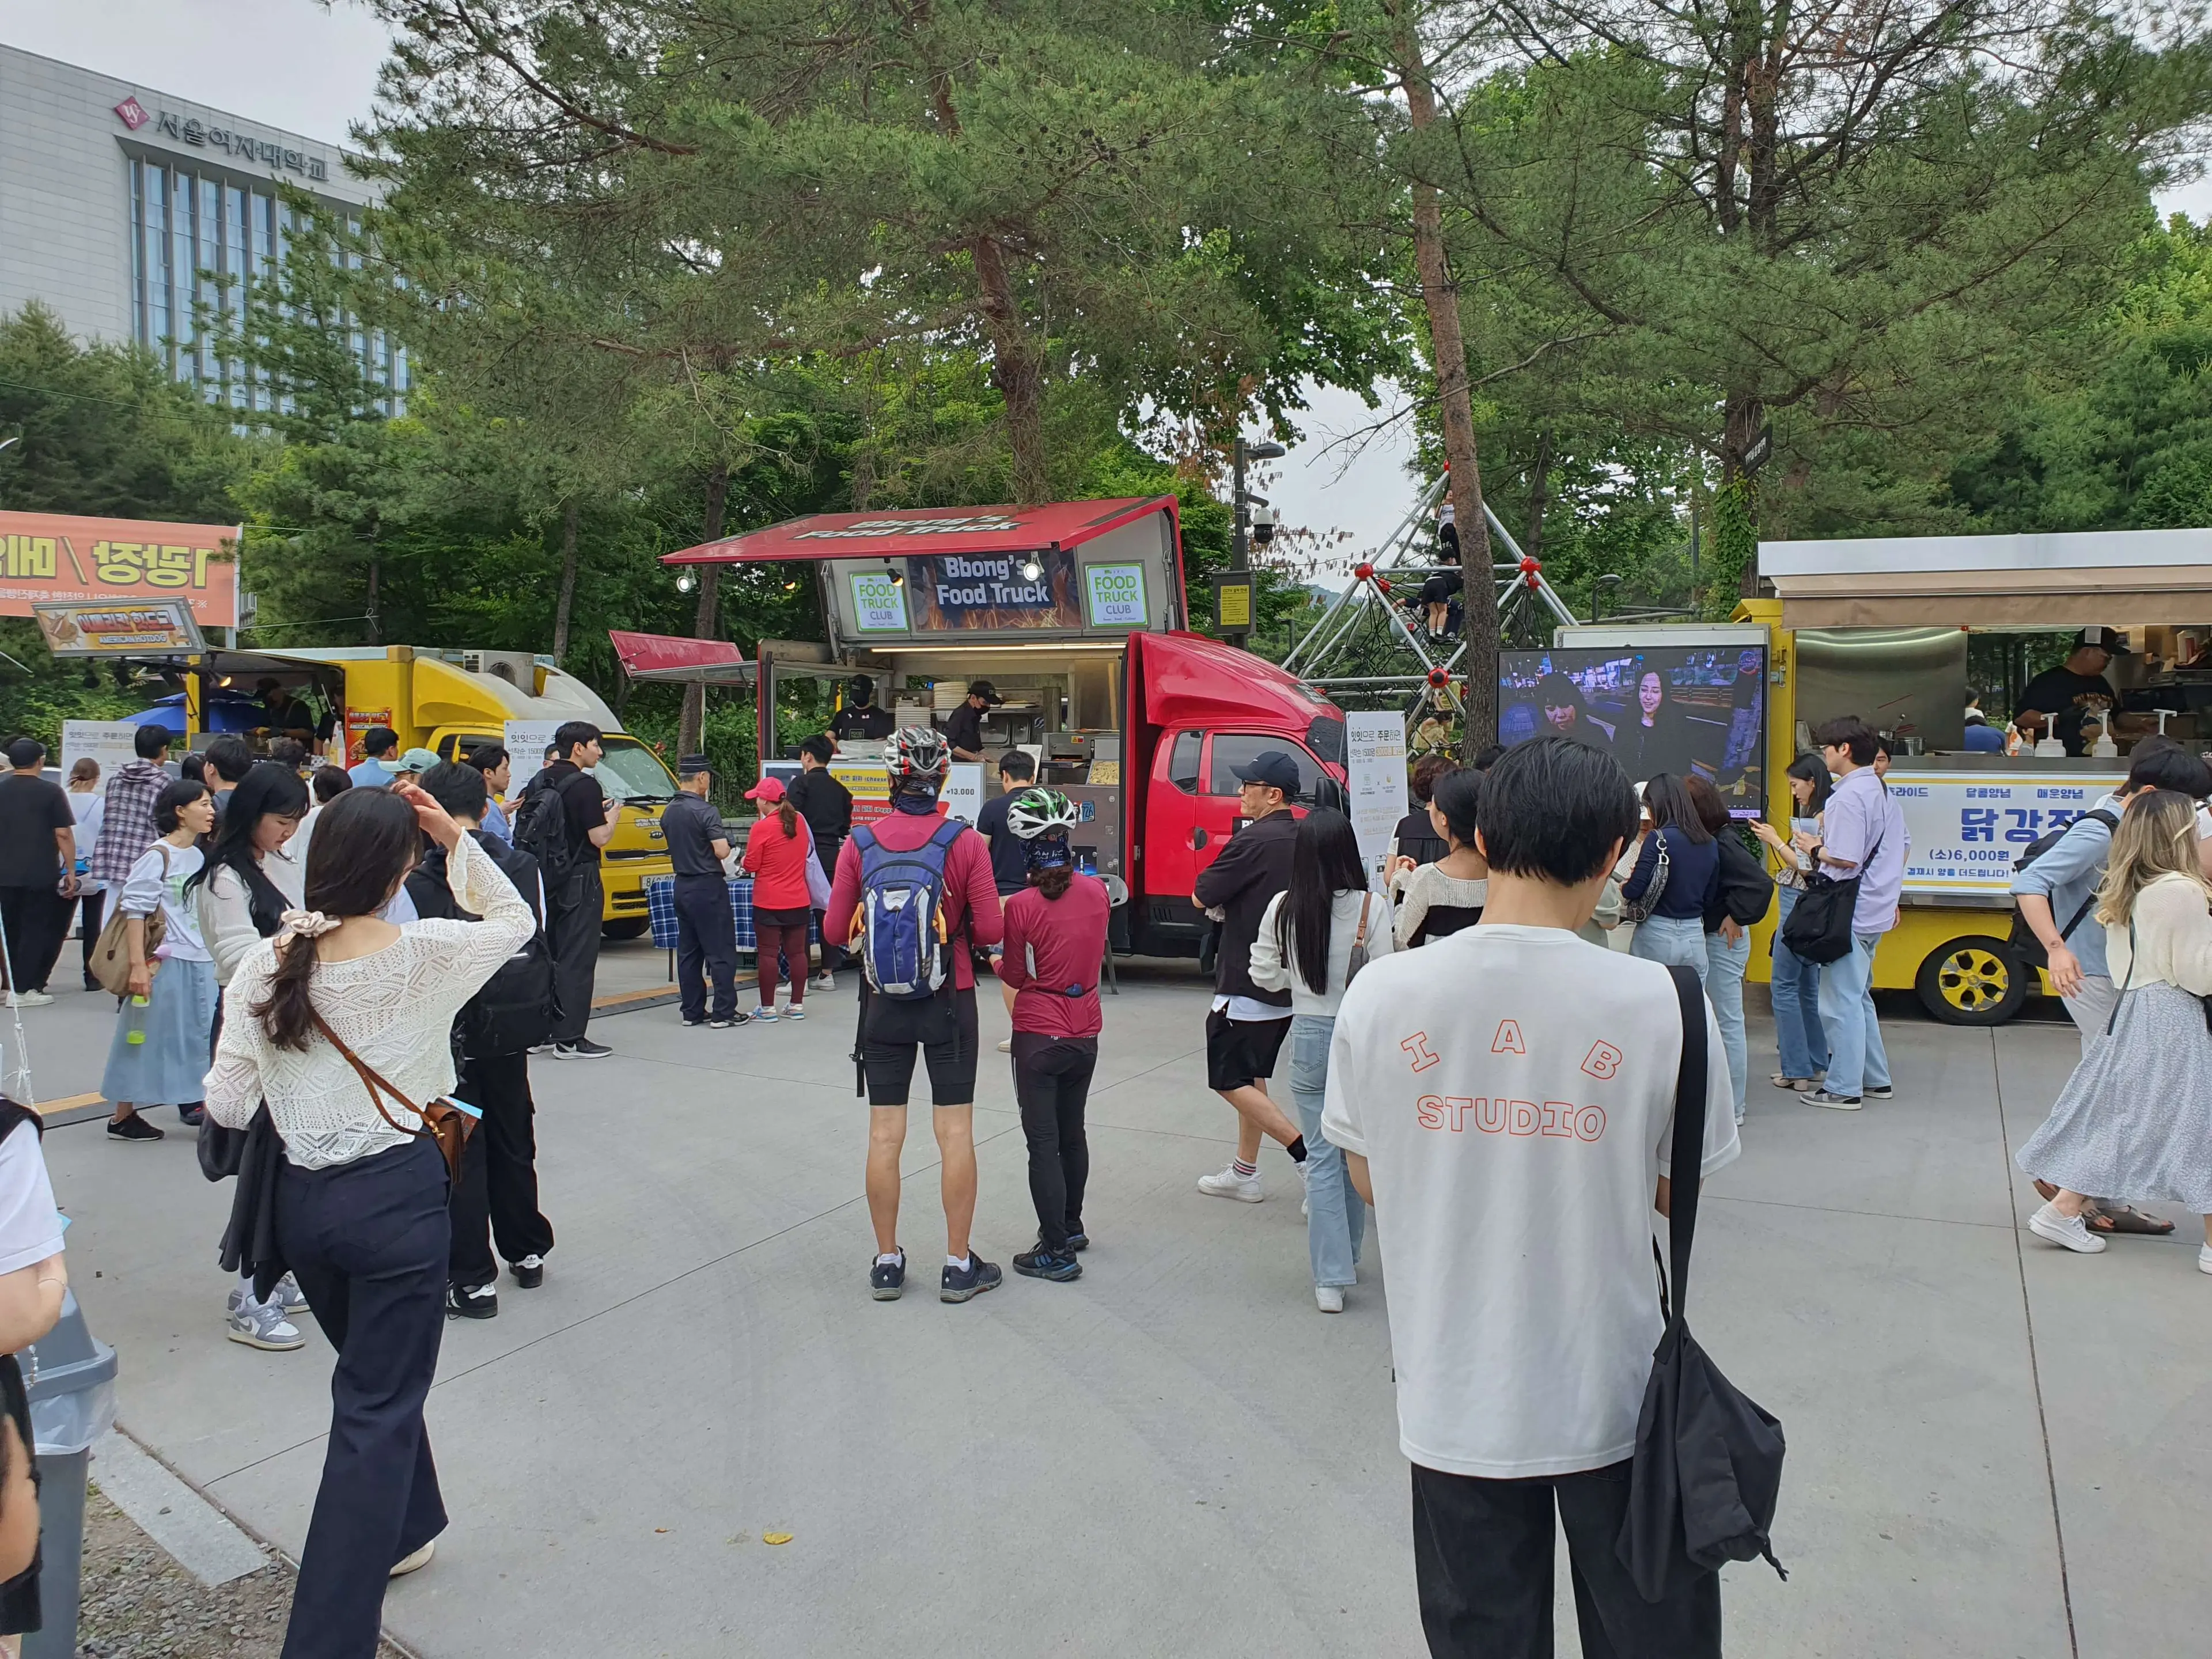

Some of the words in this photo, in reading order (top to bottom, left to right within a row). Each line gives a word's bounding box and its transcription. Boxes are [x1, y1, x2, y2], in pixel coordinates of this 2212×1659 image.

[157, 111, 329, 181] 서울여자대학교
[848, 514, 1009, 529] Bbong's
[794, 527, 905, 539] Food
[905, 522, 1021, 535] Truck
[944, 555, 1027, 581] Bbong's
[1094, 575, 1136, 590] FOOD
[859, 584, 896, 597] FOOD
[935, 583, 987, 605] Food
[990, 581, 1050, 604] Truck
[1096, 590, 1138, 603] TRUCK
[861, 599, 899, 609] TRUCK
[1105, 605, 1131, 615] CLUB
[870, 611, 893, 620] CLUB
[1377, 729, 1401, 741] 주문하면
[1965, 787, 2011, 798] 달콤양념
[2037, 788, 2084, 800] 매운양념
[1416, 1094, 1607, 1143] STUDIO
